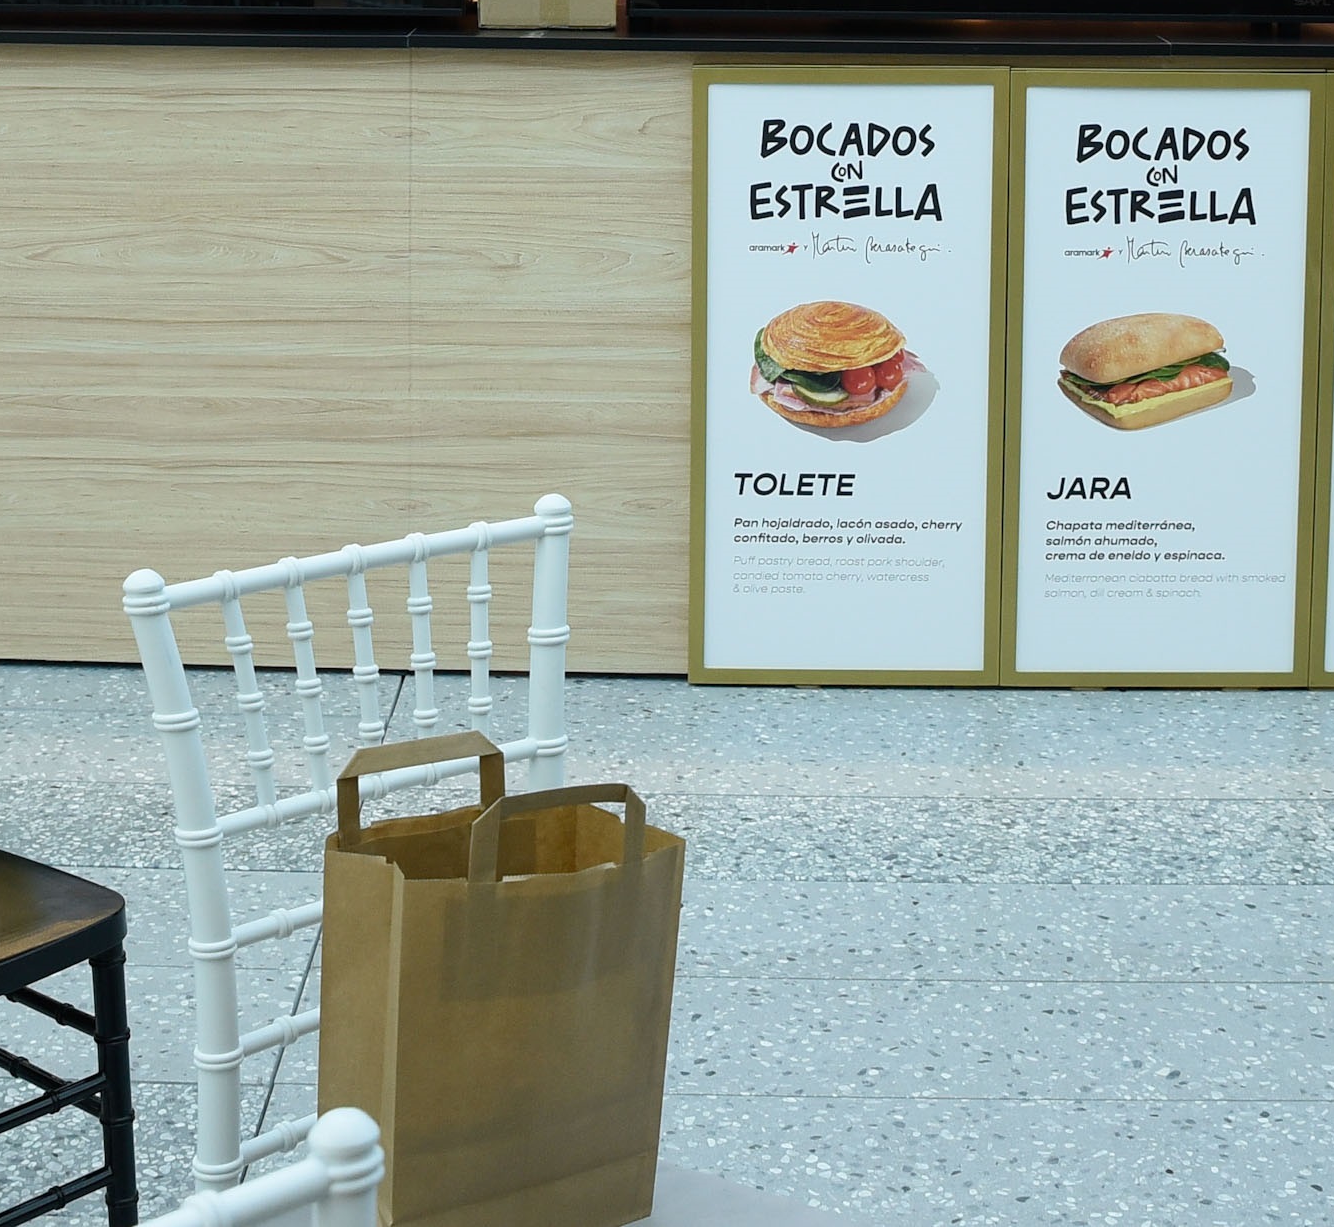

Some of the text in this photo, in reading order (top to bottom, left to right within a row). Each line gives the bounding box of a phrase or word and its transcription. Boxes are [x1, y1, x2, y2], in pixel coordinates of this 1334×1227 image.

[760, 119, 936, 159] BOCADOS
[1076, 124, 1250, 164] BOCADOS
[750, 181, 943, 222] ESTRELLA
[1066, 186, 1257, 225] ESTRELLA
[749, 243, 785, 252] aramark
[1064, 248, 1101, 257] aramark
[734, 472, 856, 496] TOLETE
[1046, 476, 1132, 500] JARA
[733, 518, 963, 532] Pan hojaldrado, lacón asado, cherry
[1046, 520, 1196, 533] Chapata mediterránea,
[733, 533, 906, 547] confitado, berros y olivada.
[1045, 536, 1158, 548] salmón ahumado,
[1045, 550, 1226, 563] crema de eneldo y espinaca.
